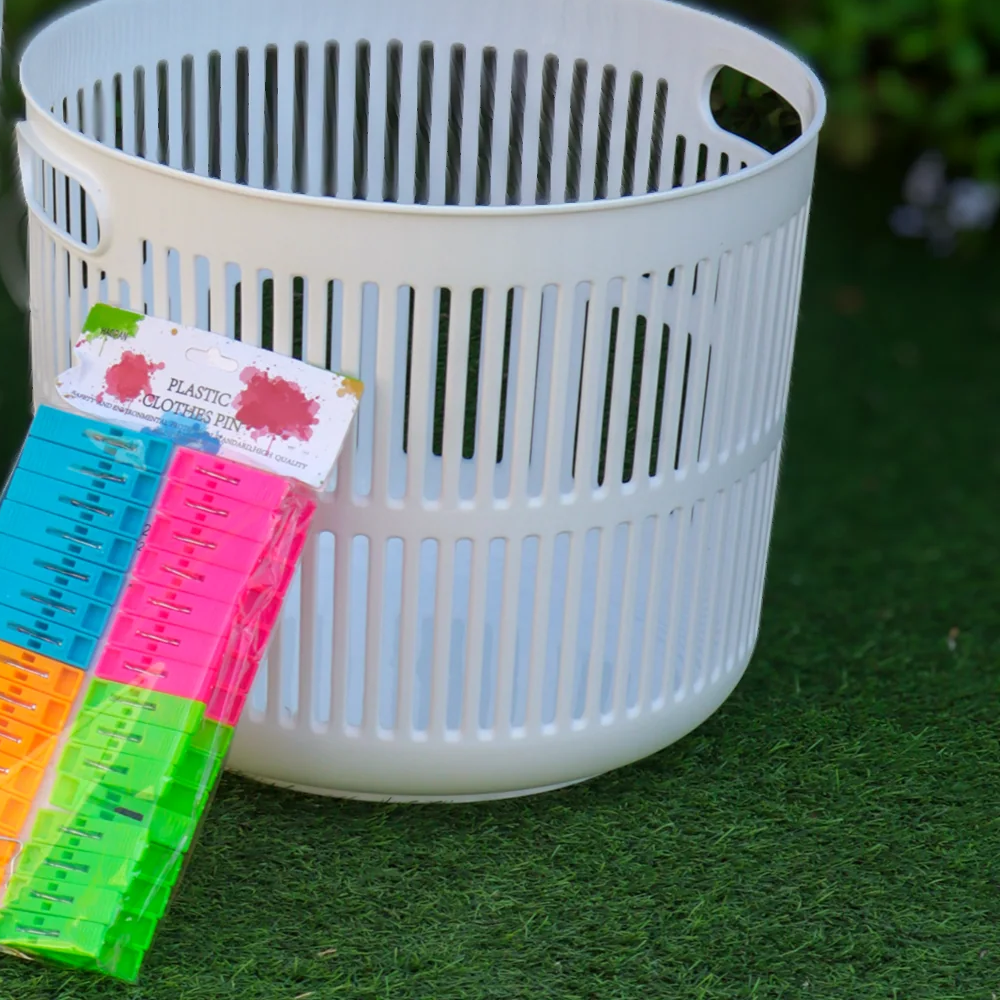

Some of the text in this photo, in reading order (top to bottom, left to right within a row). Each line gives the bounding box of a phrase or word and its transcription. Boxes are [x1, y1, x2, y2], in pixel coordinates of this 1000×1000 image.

[166, 377, 232, 408] PLASTIC
[142, 393, 243, 433] CLOTHES PIN
[274, 453, 309, 470] QUALITY
